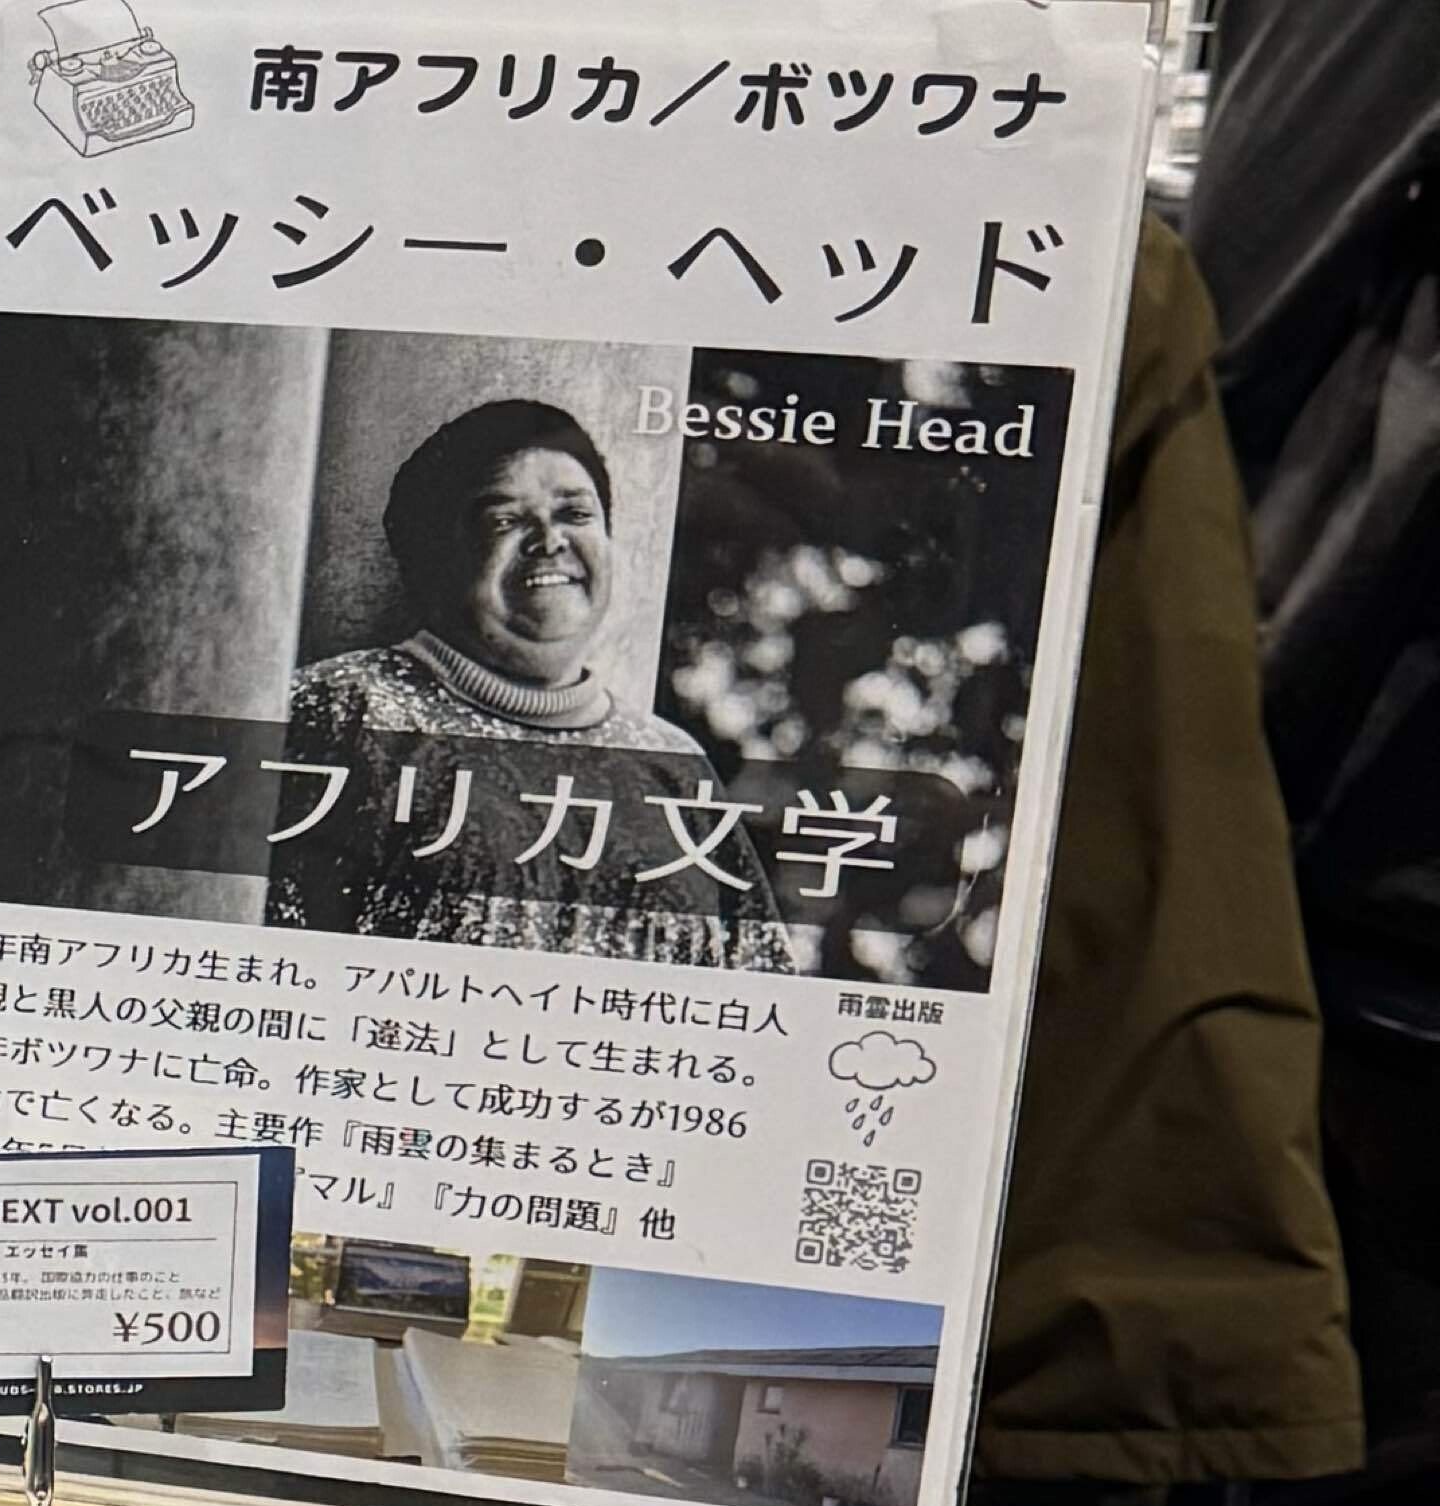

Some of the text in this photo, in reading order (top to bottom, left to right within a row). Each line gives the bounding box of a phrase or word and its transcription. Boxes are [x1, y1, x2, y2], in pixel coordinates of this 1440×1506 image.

[249, 42, 1069, 142] 南アフリカ／ボツワナ
[4, 183, 1069, 328] ベッシー・ヘッド
[636, 383, 1036, 461] Bessie Head
[127, 745, 901, 901] アフリカ文学
[839, 993, 944, 1025] 雨雲出版
[71, 1197, 193, 1225] vol.001
[295, 1165, 676, 1241] マル』『力の問題』他
[113, 1310, 221, 1346] ¥500
